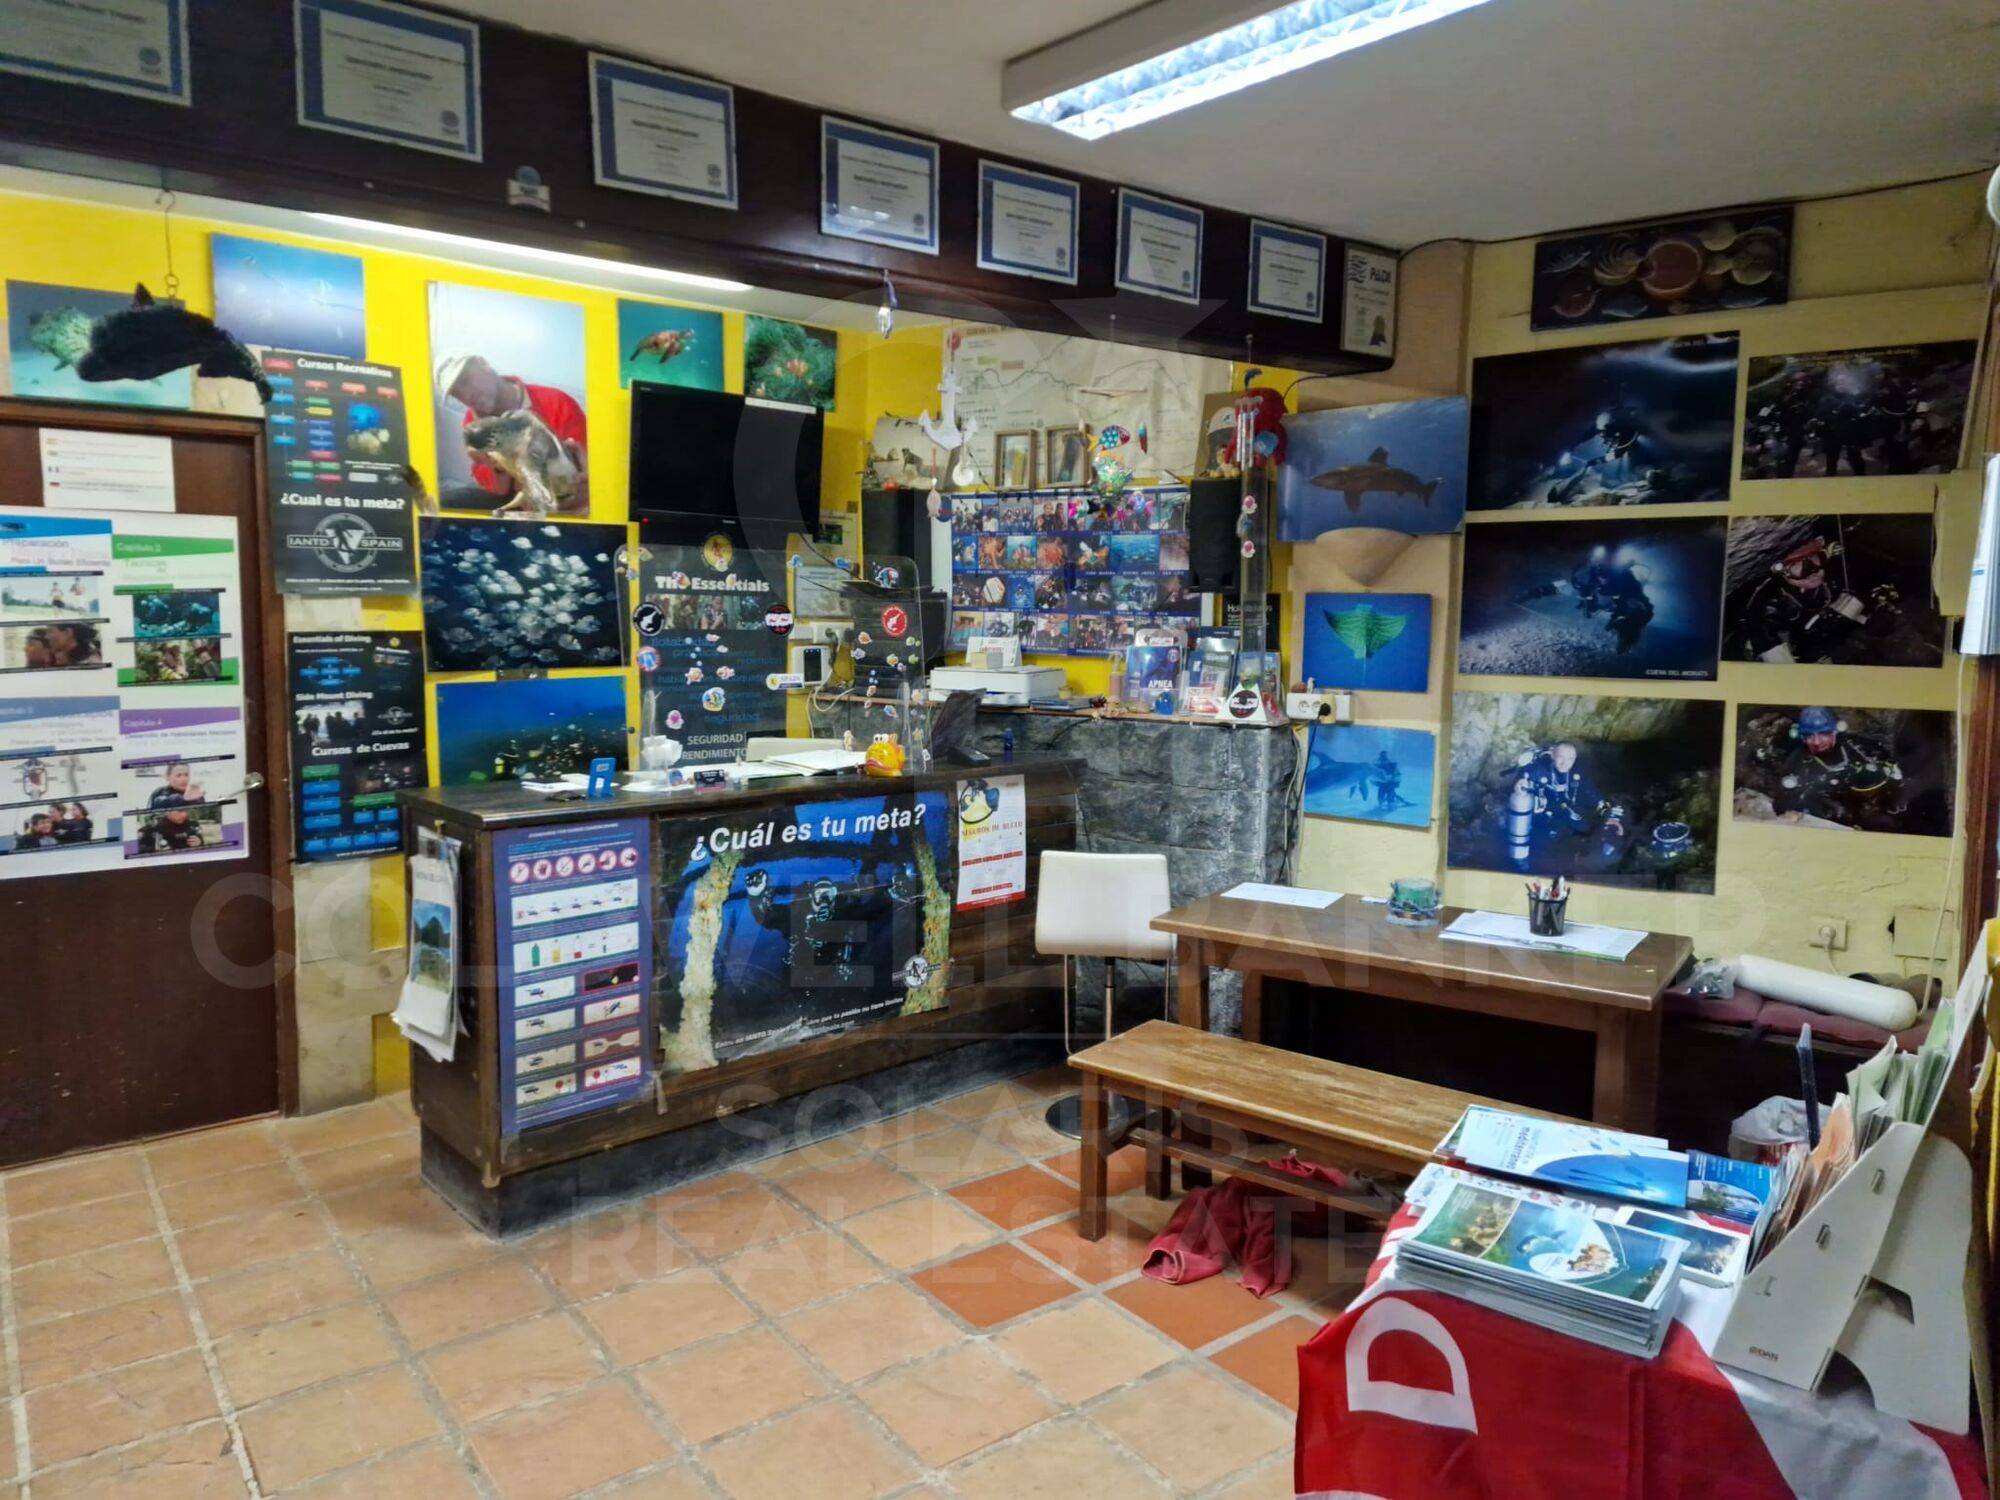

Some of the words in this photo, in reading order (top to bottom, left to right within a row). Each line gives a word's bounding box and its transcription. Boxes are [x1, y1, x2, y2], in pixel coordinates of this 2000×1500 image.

[297, 358, 335, 372] Cursos
[336, 362, 394, 379] Recreativos
[324, 497, 341, 507] es
[344, 496, 360, 508] tu
[363, 498, 406, 510] meta?
[289, 537, 330, 547] IANTD
[360, 538, 401, 548] SPAIN
[655, 575, 690, 590] Th
[1147, 679, 1174, 689] APNEA
[345, 690, 374, 701] Diving
[687, 733, 744, 746] SEGURIDAD
[312, 745, 352, 757] Cursos
[356, 743, 371, 754] de
[372, 741, 410, 753] Cuevas
[690, 821, 775, 862] ¿Cuál
[781, 822, 812, 843] es
[820, 815, 847, 838] tu
[854, 803, 928, 834] meta?
